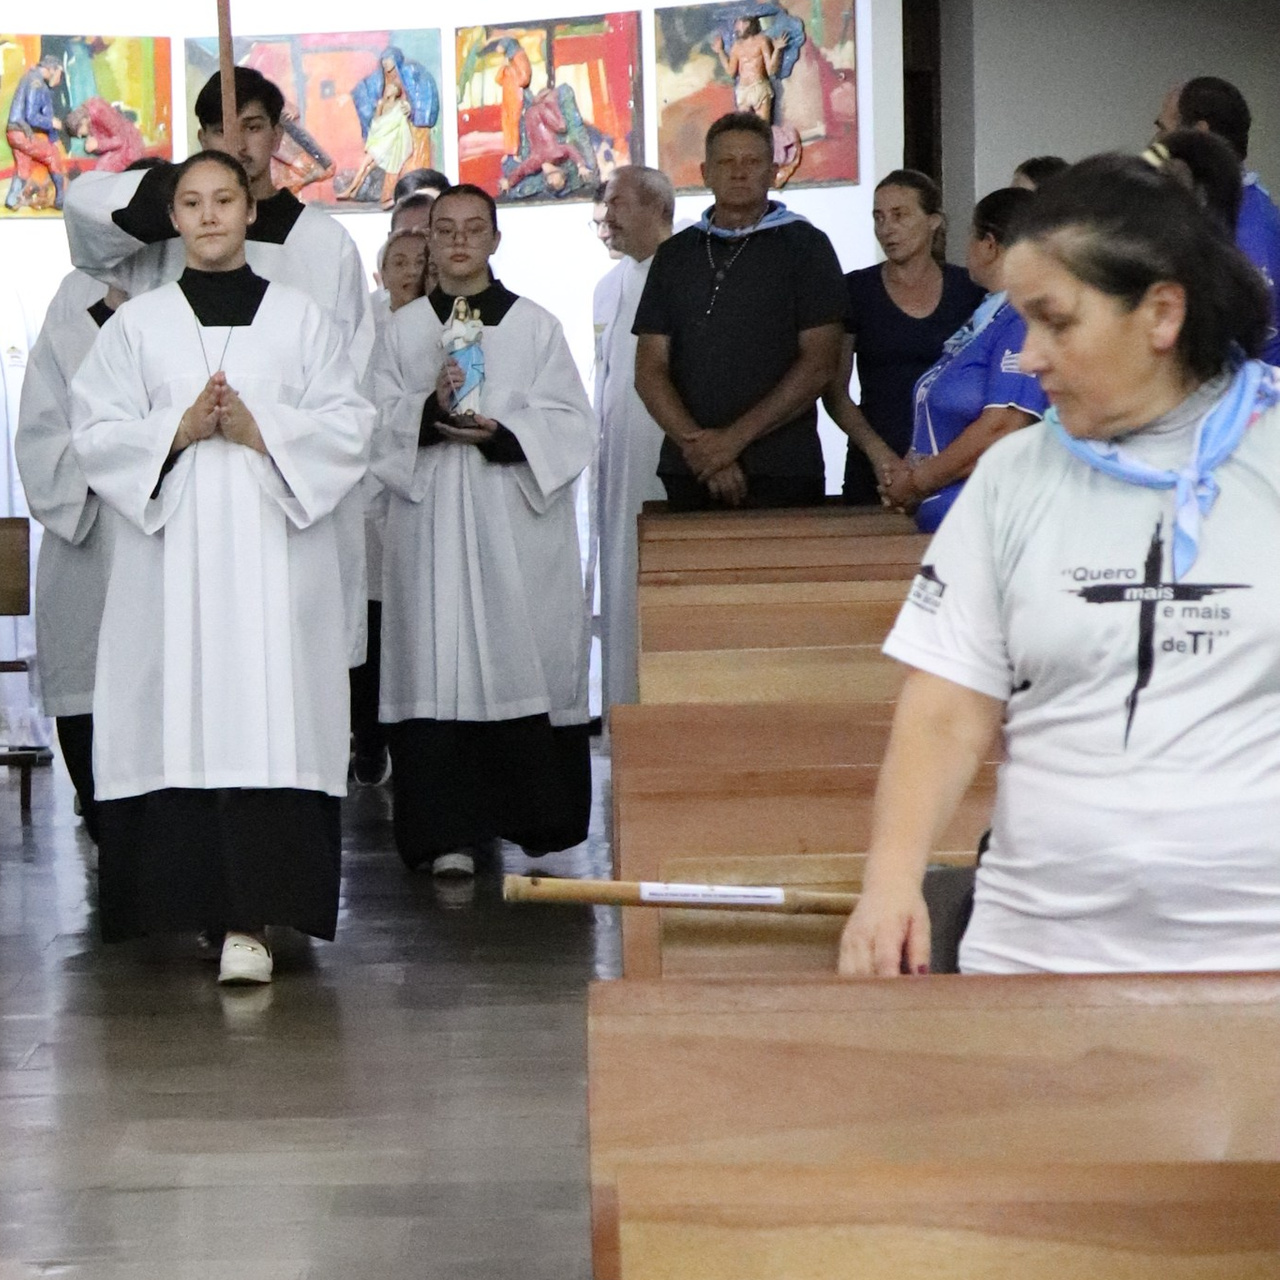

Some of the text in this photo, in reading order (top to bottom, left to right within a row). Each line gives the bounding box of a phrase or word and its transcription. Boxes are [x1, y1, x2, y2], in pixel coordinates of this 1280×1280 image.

[1124, 584, 1174, 601] mais
[1163, 604, 1231, 620] e mais
